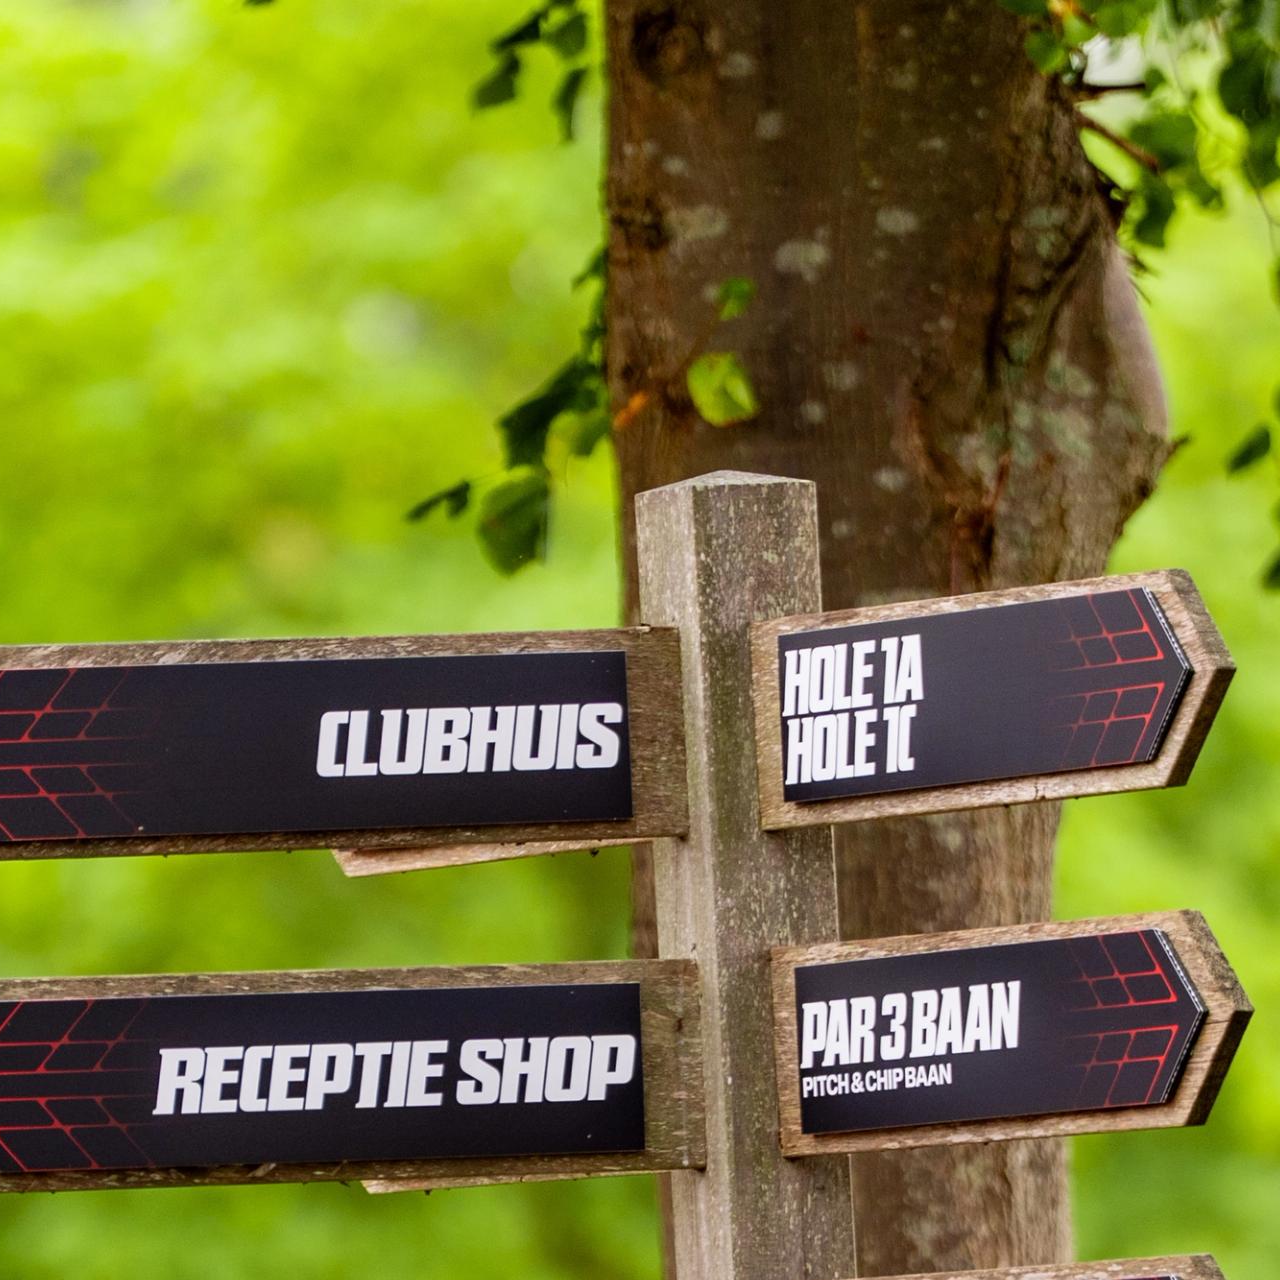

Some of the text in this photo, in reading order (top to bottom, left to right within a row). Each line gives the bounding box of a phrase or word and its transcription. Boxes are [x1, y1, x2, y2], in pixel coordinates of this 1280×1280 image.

[782, 634, 925, 717] HOLE 1A
[317, 703, 623, 778] CLUBHUIS
[785, 704, 918, 786] HOLE 1C
[800, 980, 1022, 1069] PAR 3 BAAN
[153, 1035, 636, 1115] RECEPTIE SHOP
[803, 1073, 851, 1099] PITCH
[865, 1069, 904, 1091] CHIP
[905, 1063, 953, 1089] BAAN
